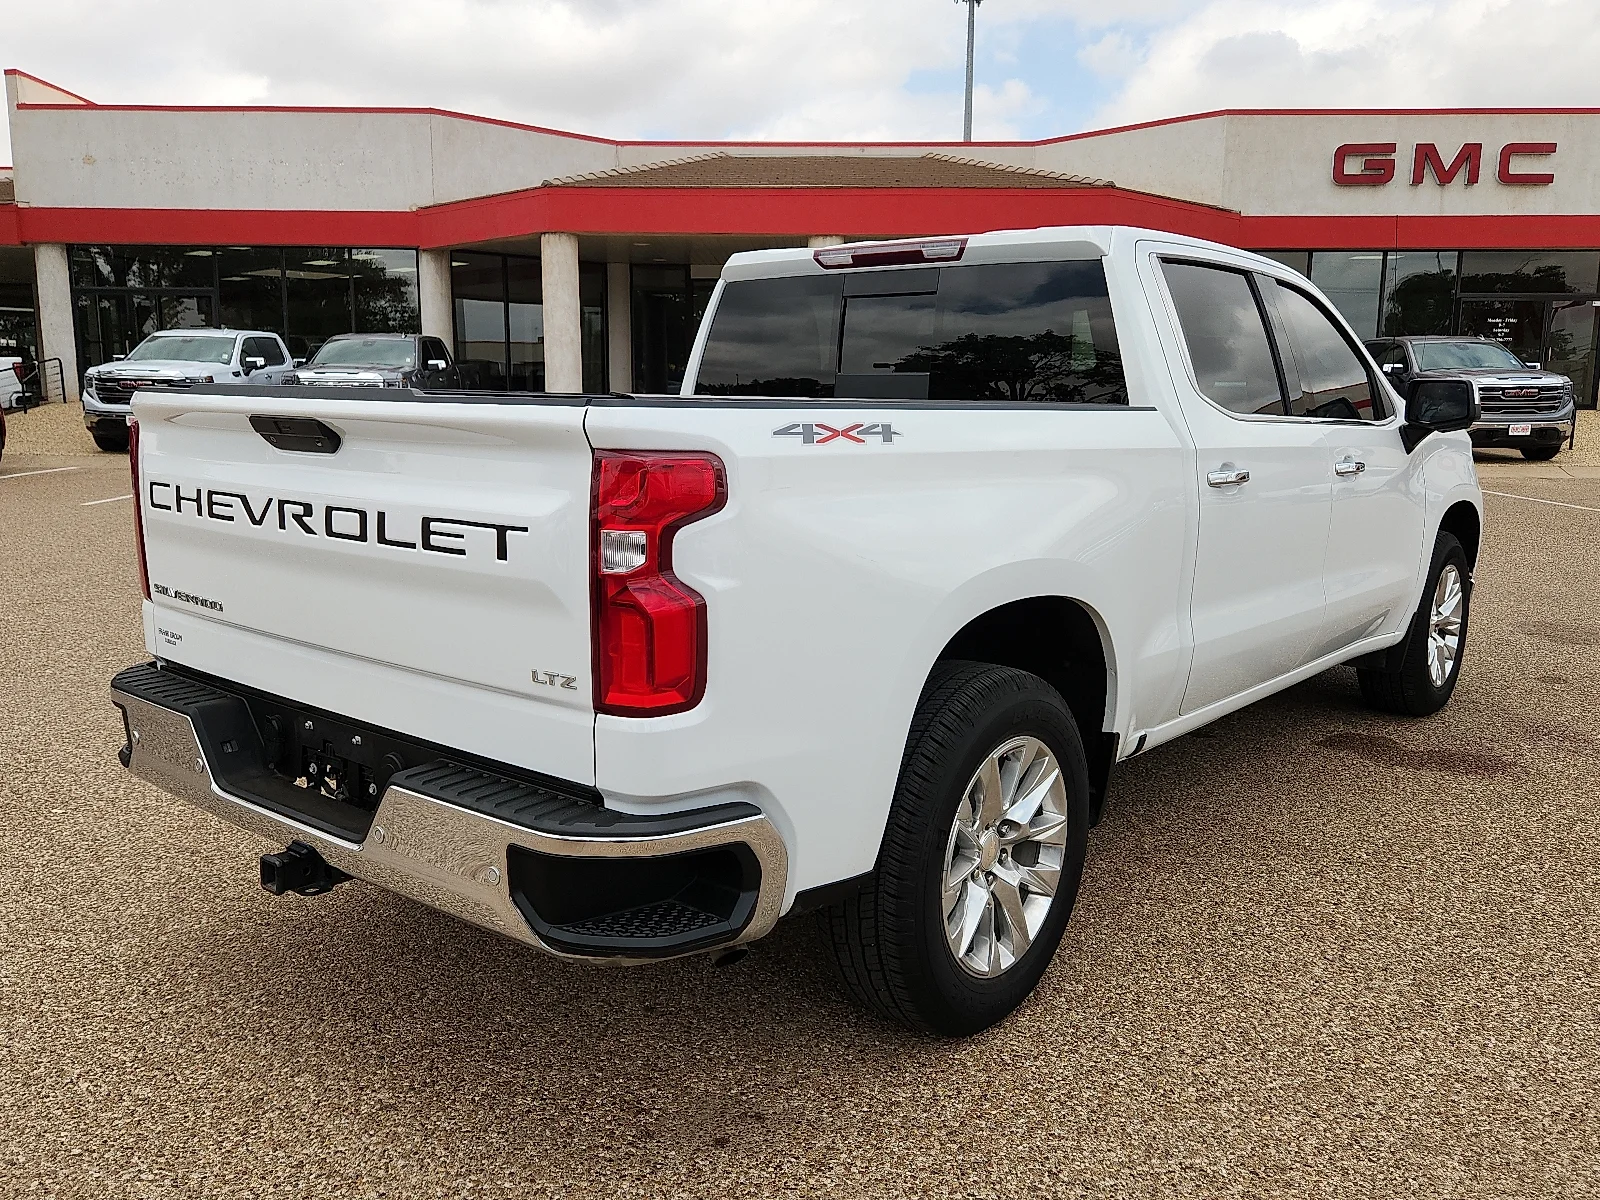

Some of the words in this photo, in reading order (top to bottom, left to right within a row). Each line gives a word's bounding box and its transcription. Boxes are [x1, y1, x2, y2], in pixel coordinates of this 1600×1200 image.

[1331, 142, 1557, 186] GMC
[149, 481, 529, 562] CHEVROLET
[531, 669, 578, 690] LTZ
